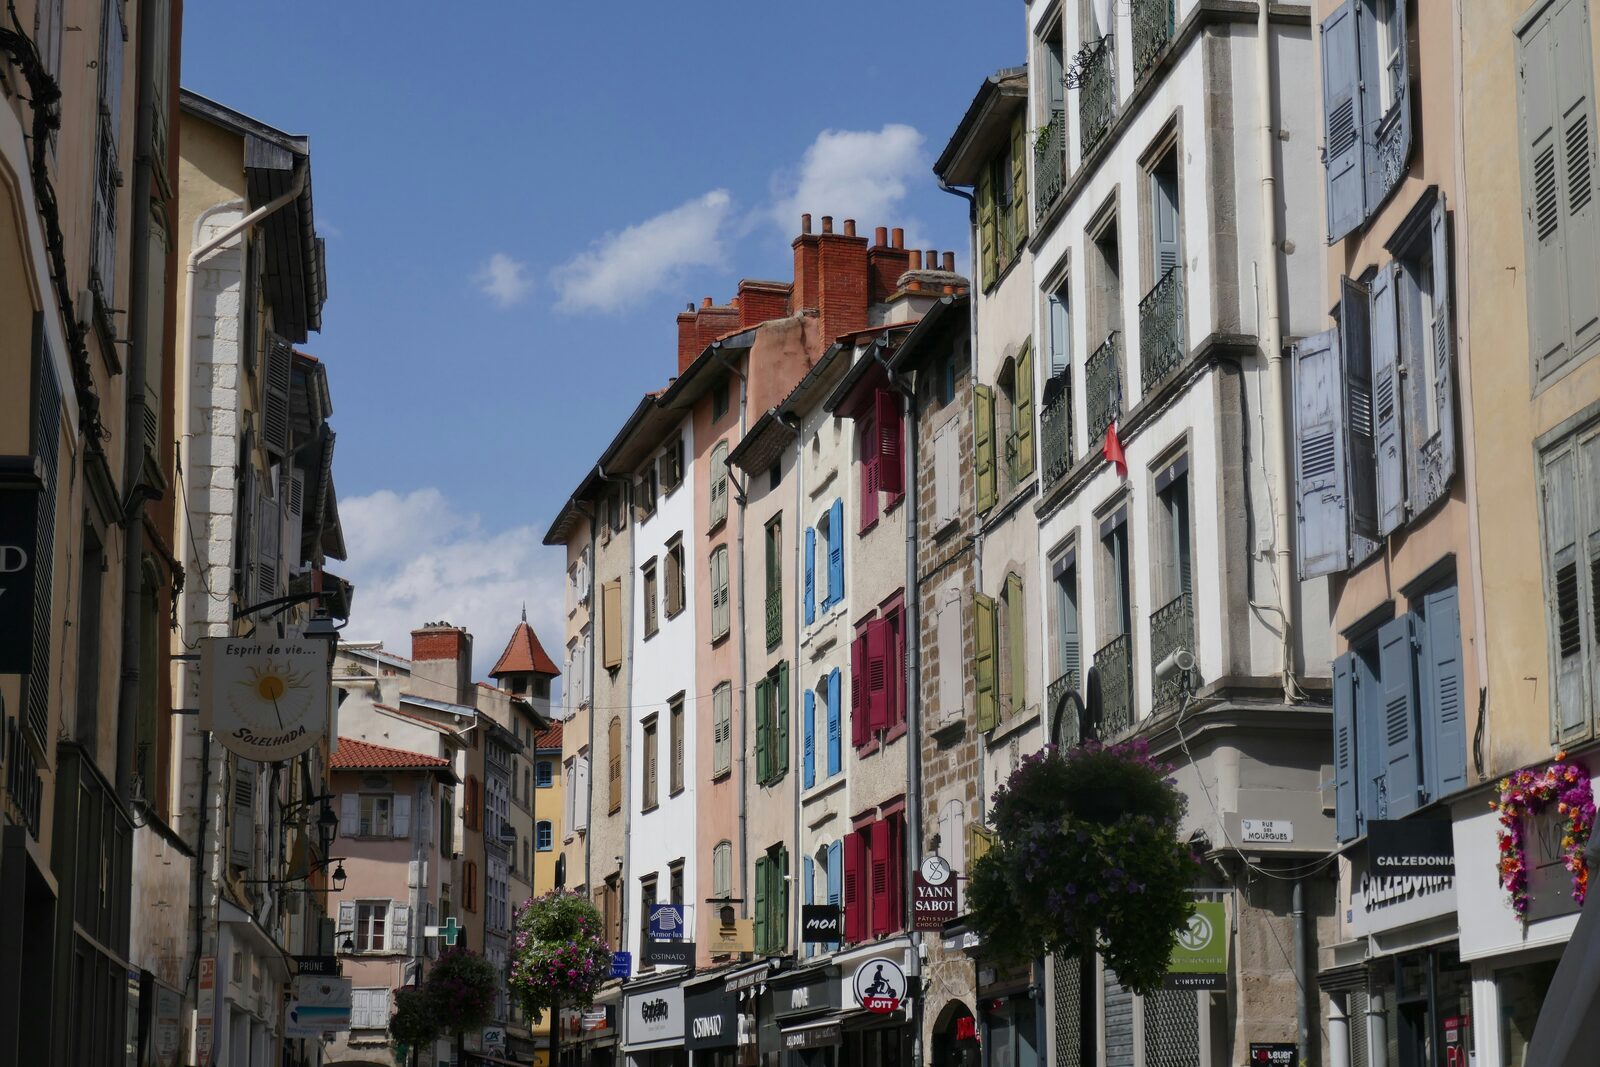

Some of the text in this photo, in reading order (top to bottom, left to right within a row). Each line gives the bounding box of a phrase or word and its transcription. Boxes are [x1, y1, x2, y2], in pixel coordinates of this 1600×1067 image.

[226, 644, 317, 657] Esprit de vie...
[232, 724, 306, 747] SOLELHADA
[1248, 832, 1288, 841] MOURGUES
[1377, 856, 1456, 866] CALZEDONIA
[917, 886, 953, 898] YANN
[1360, 871, 1450, 908] CALZED
[915, 900, 955, 911] SABOT
[806, 918, 838, 930] MOA
[299, 961, 324, 972] PRUNE
[869, 999, 893, 1009] JOTT
[693, 1014, 722, 1039] OSTINATO
